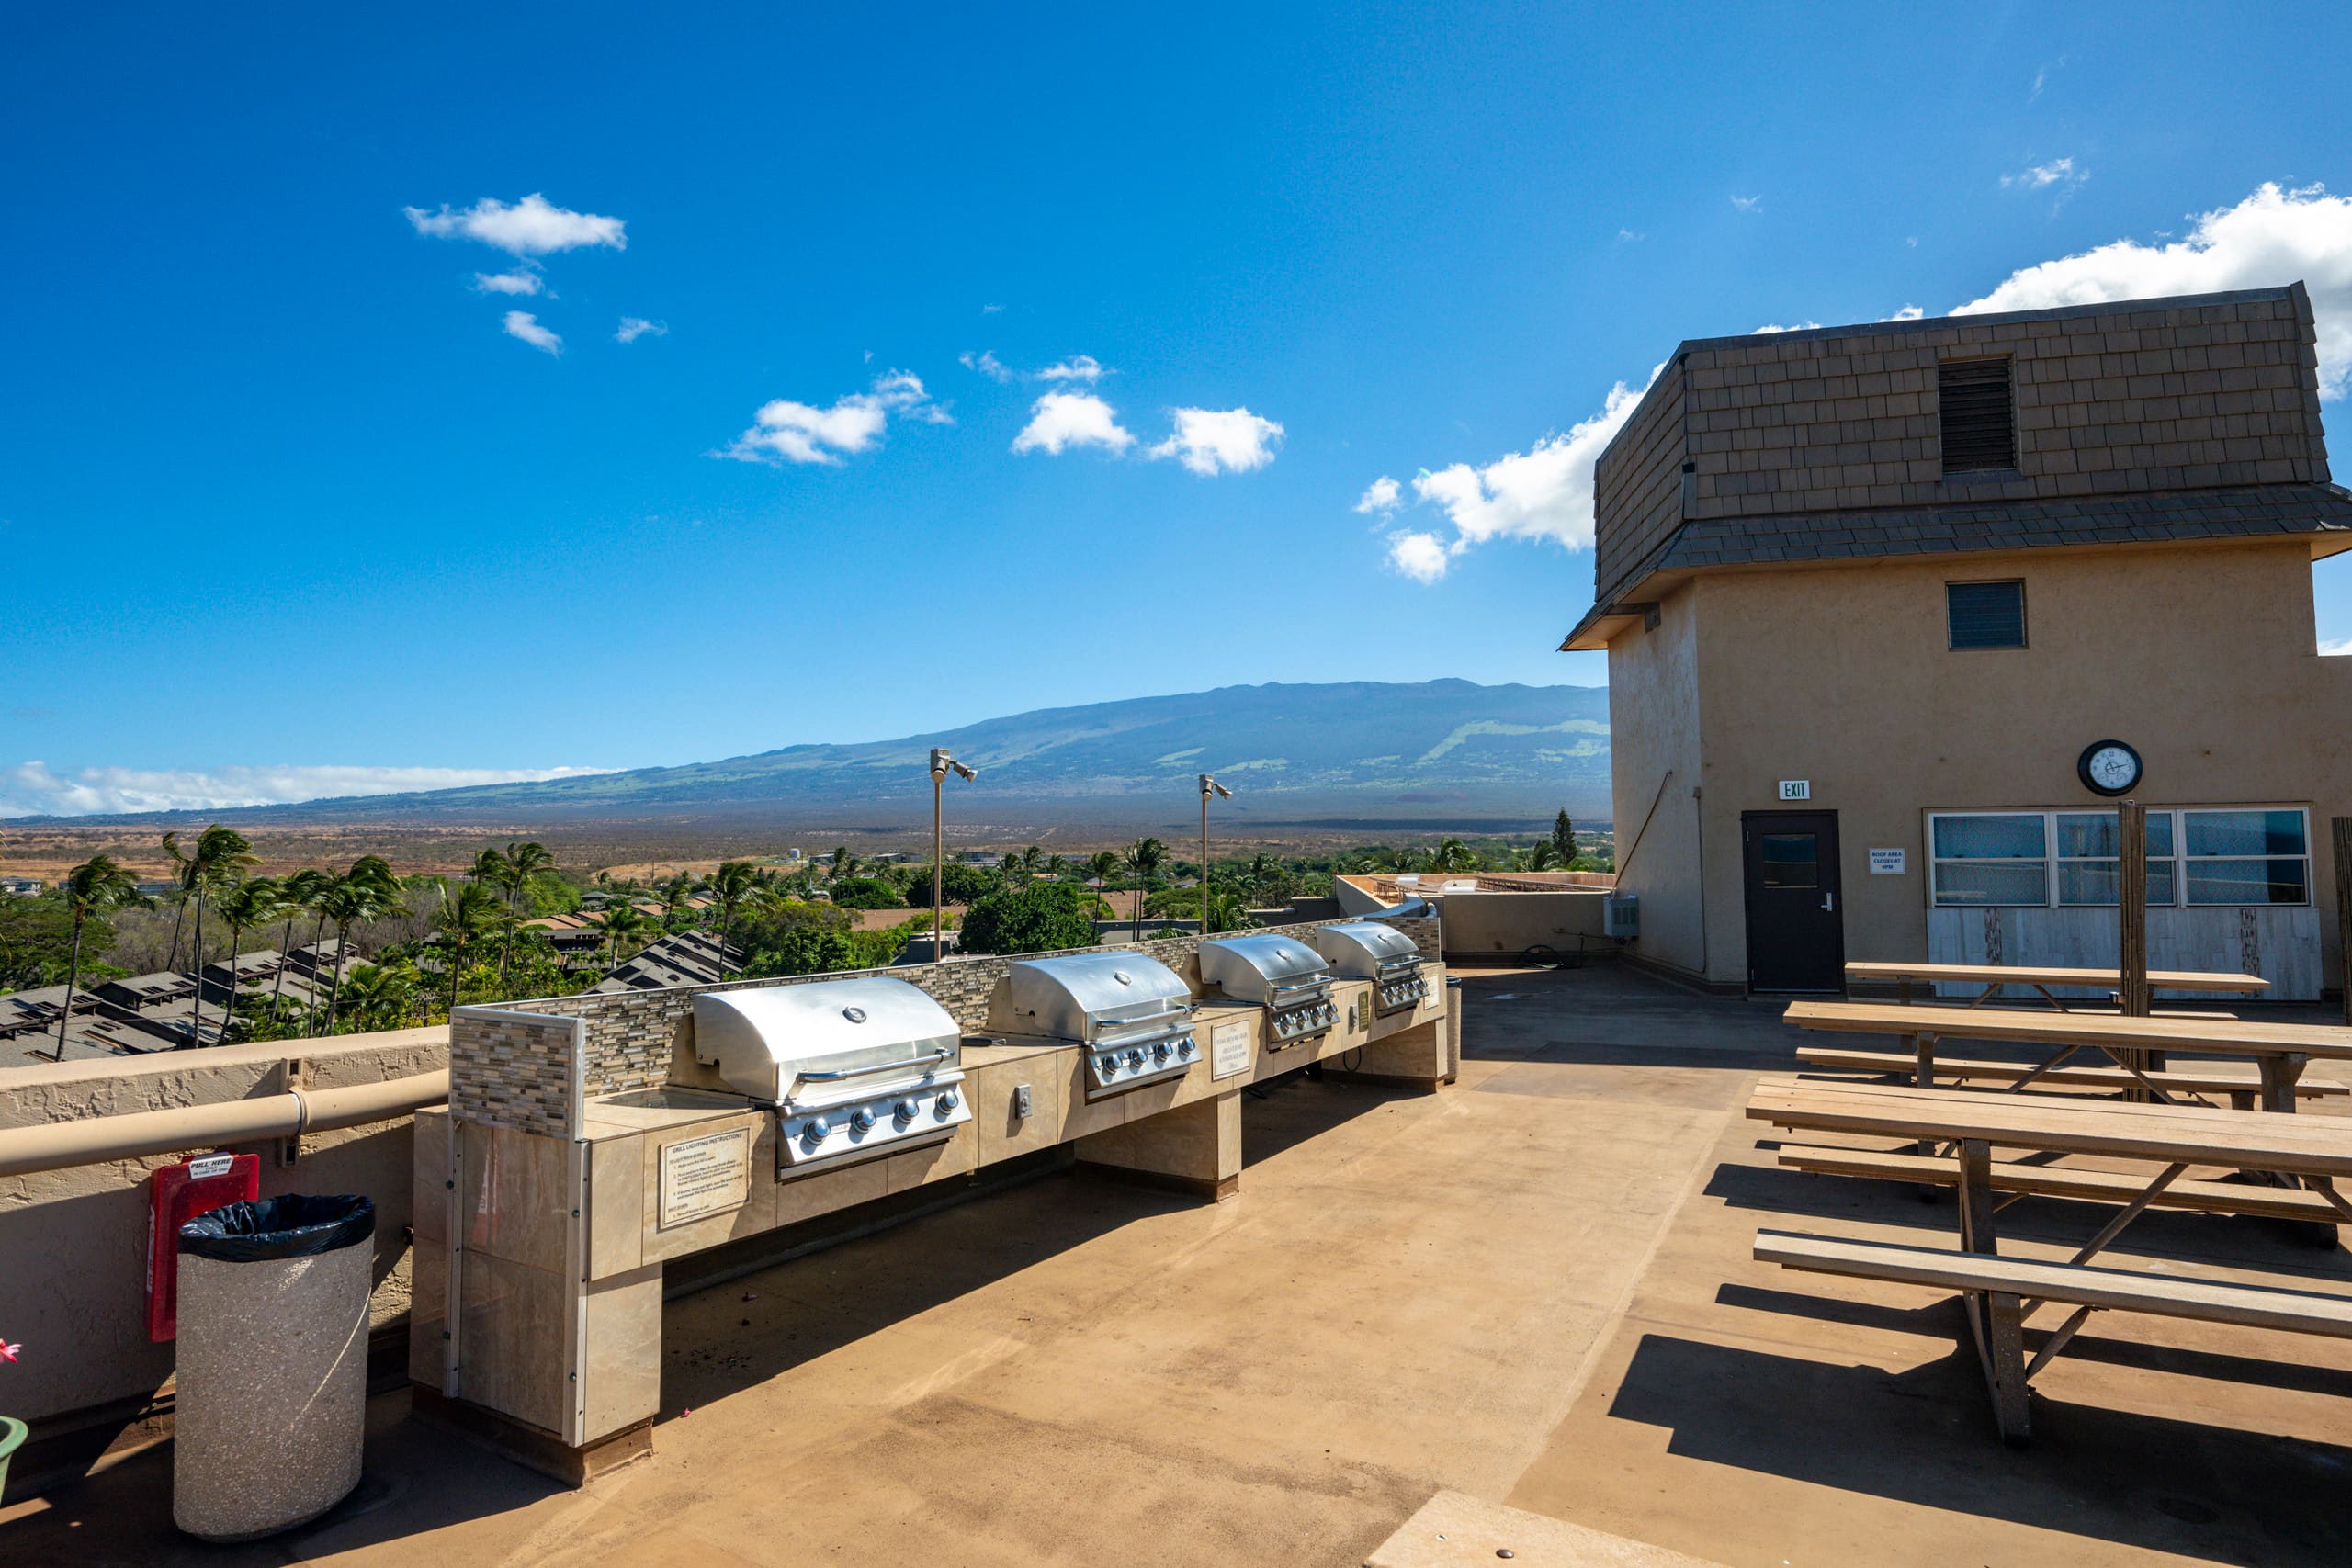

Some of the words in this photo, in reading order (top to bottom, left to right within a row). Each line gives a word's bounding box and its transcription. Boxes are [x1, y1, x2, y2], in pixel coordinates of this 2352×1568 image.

[1784, 783, 1805, 797] EXIT
[686, 1141, 708, 1150] LIGHTING
[709, 1133, 741, 1145] INSTRUCTIONS
